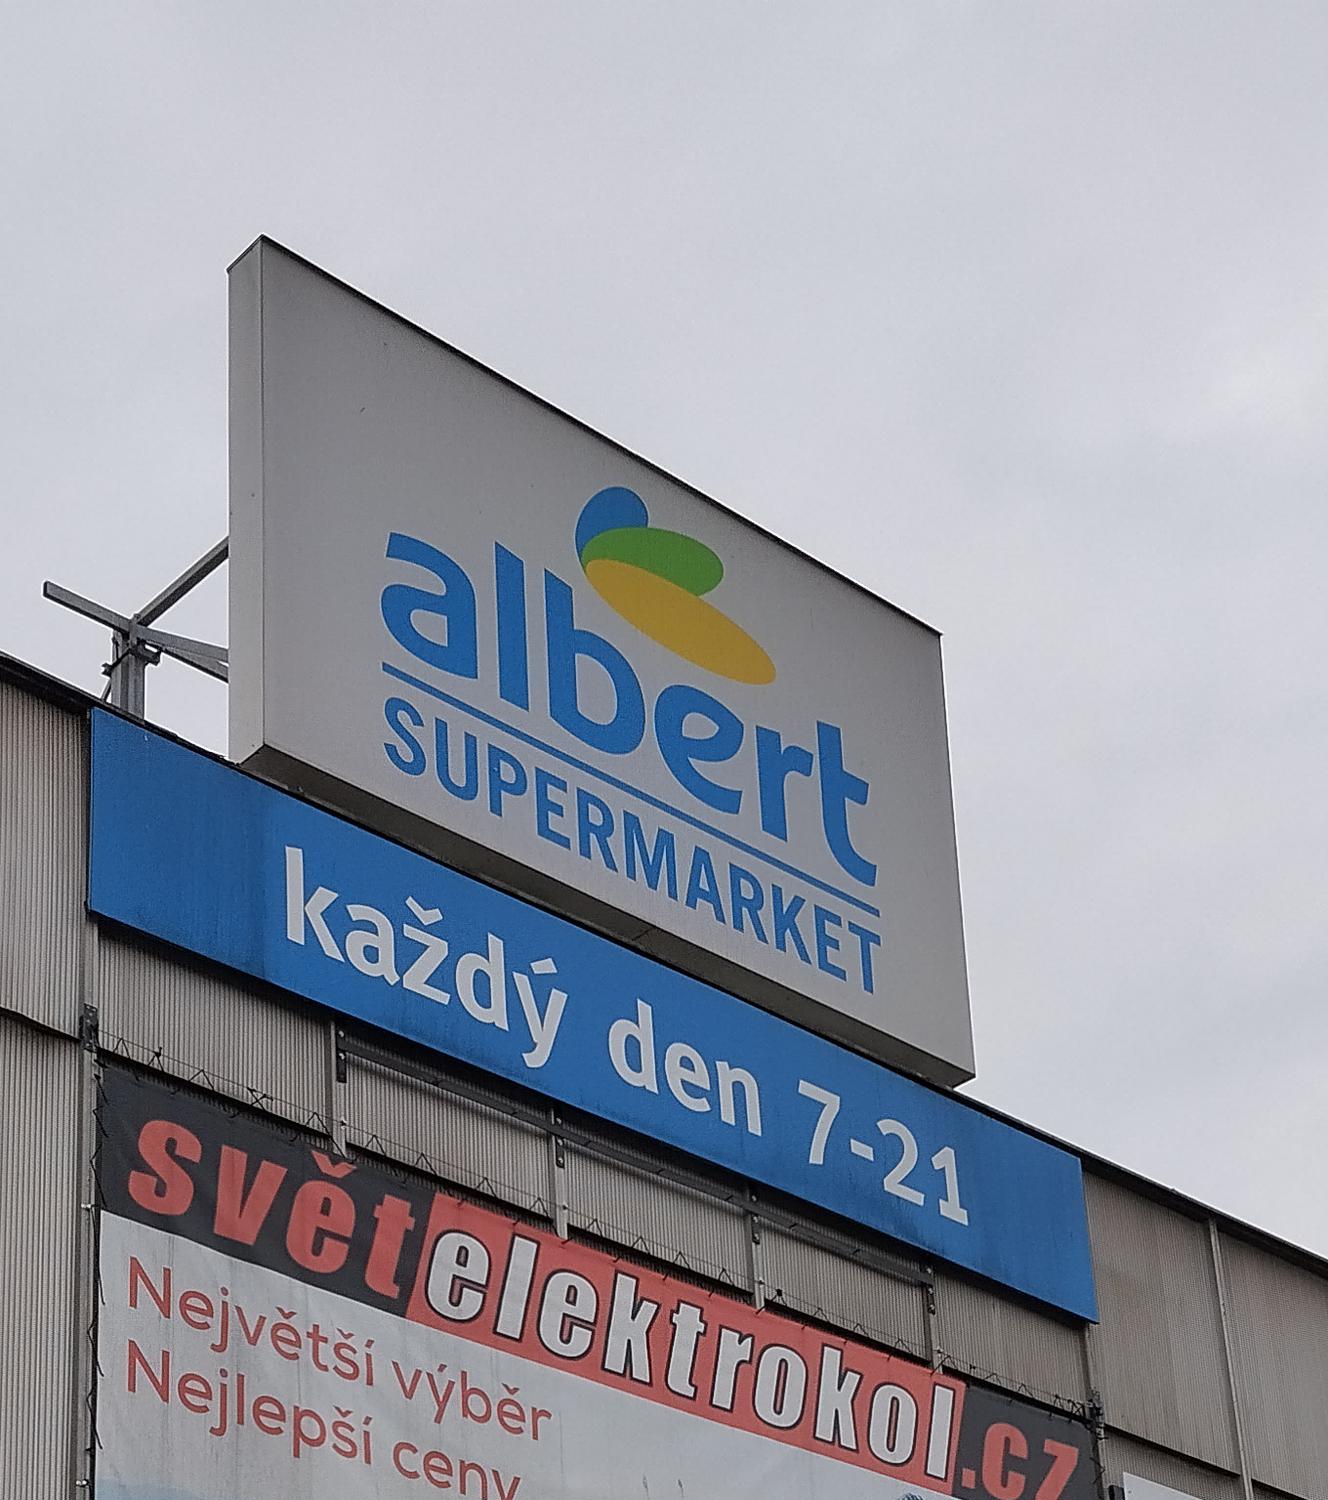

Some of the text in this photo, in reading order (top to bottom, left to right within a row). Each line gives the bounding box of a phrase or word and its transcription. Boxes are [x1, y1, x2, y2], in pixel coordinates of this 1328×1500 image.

[380, 531, 878, 887] albert
[383, 696, 882, 995] SUPERMARKET
[285, 845, 969, 1226] každý den 7-21
[126, 1337, 375, 1469] Nejlepší
[127, 1256, 553, 1446] Největší výběr
